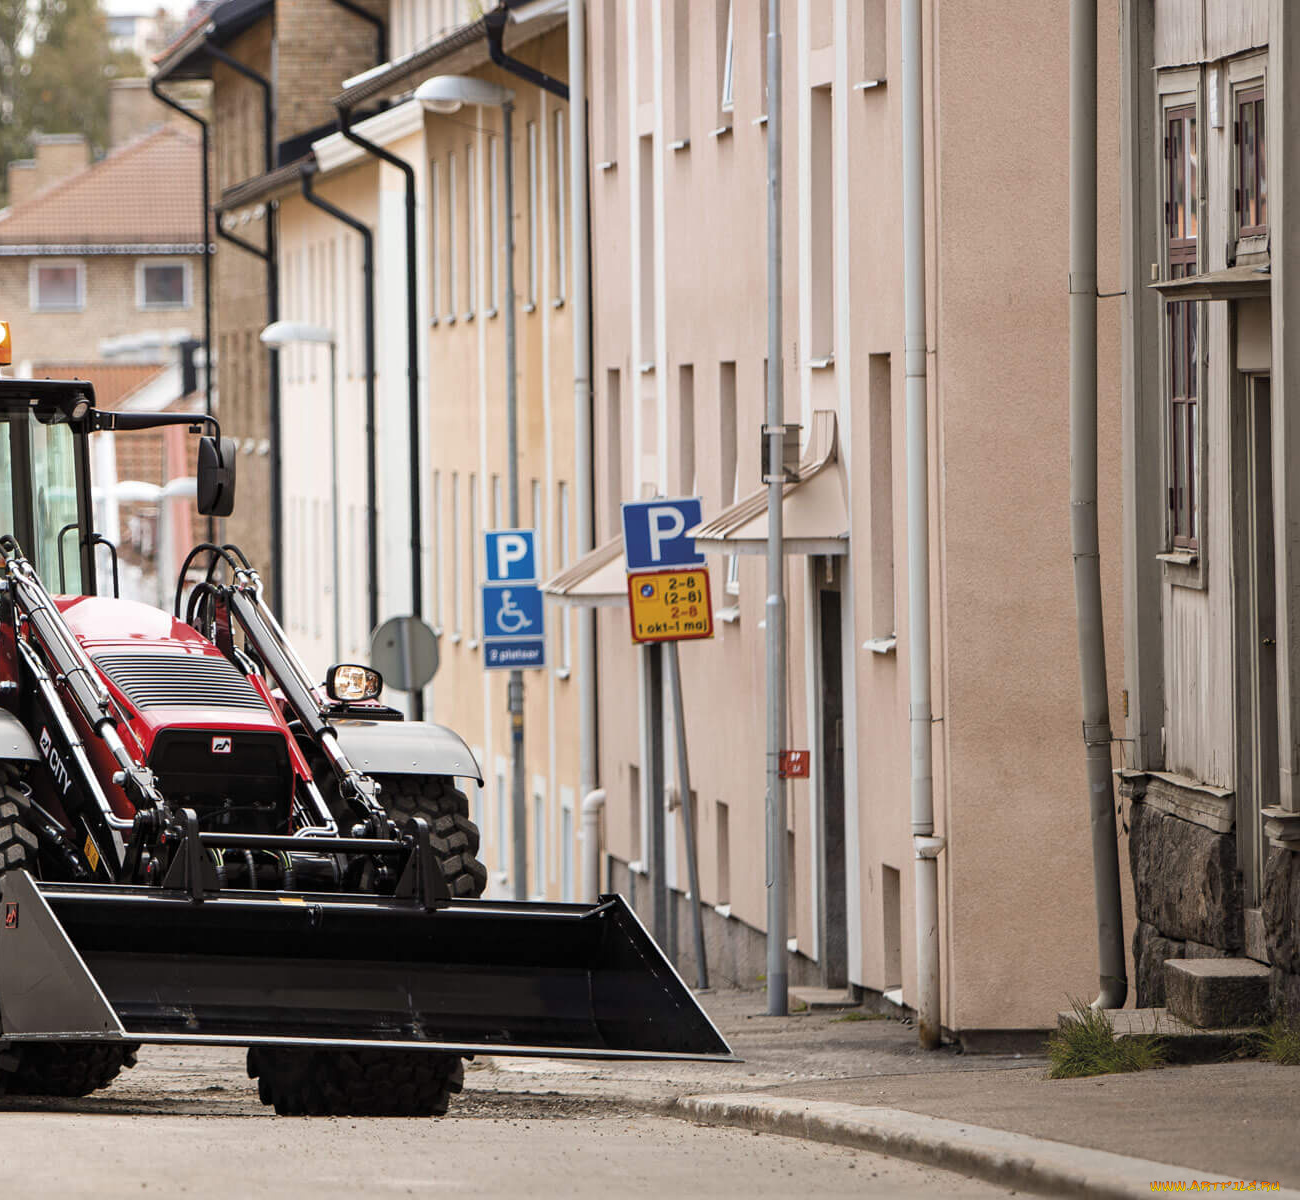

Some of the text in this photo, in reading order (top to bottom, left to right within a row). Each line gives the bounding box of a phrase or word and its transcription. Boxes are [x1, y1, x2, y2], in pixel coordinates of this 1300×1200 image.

[496, 534, 528, 578] P
[647, 506, 685, 562] P
[638, 623, 643, 634] 1
[683, 618, 708, 633] maj
[50, 747, 72, 795] CITY
